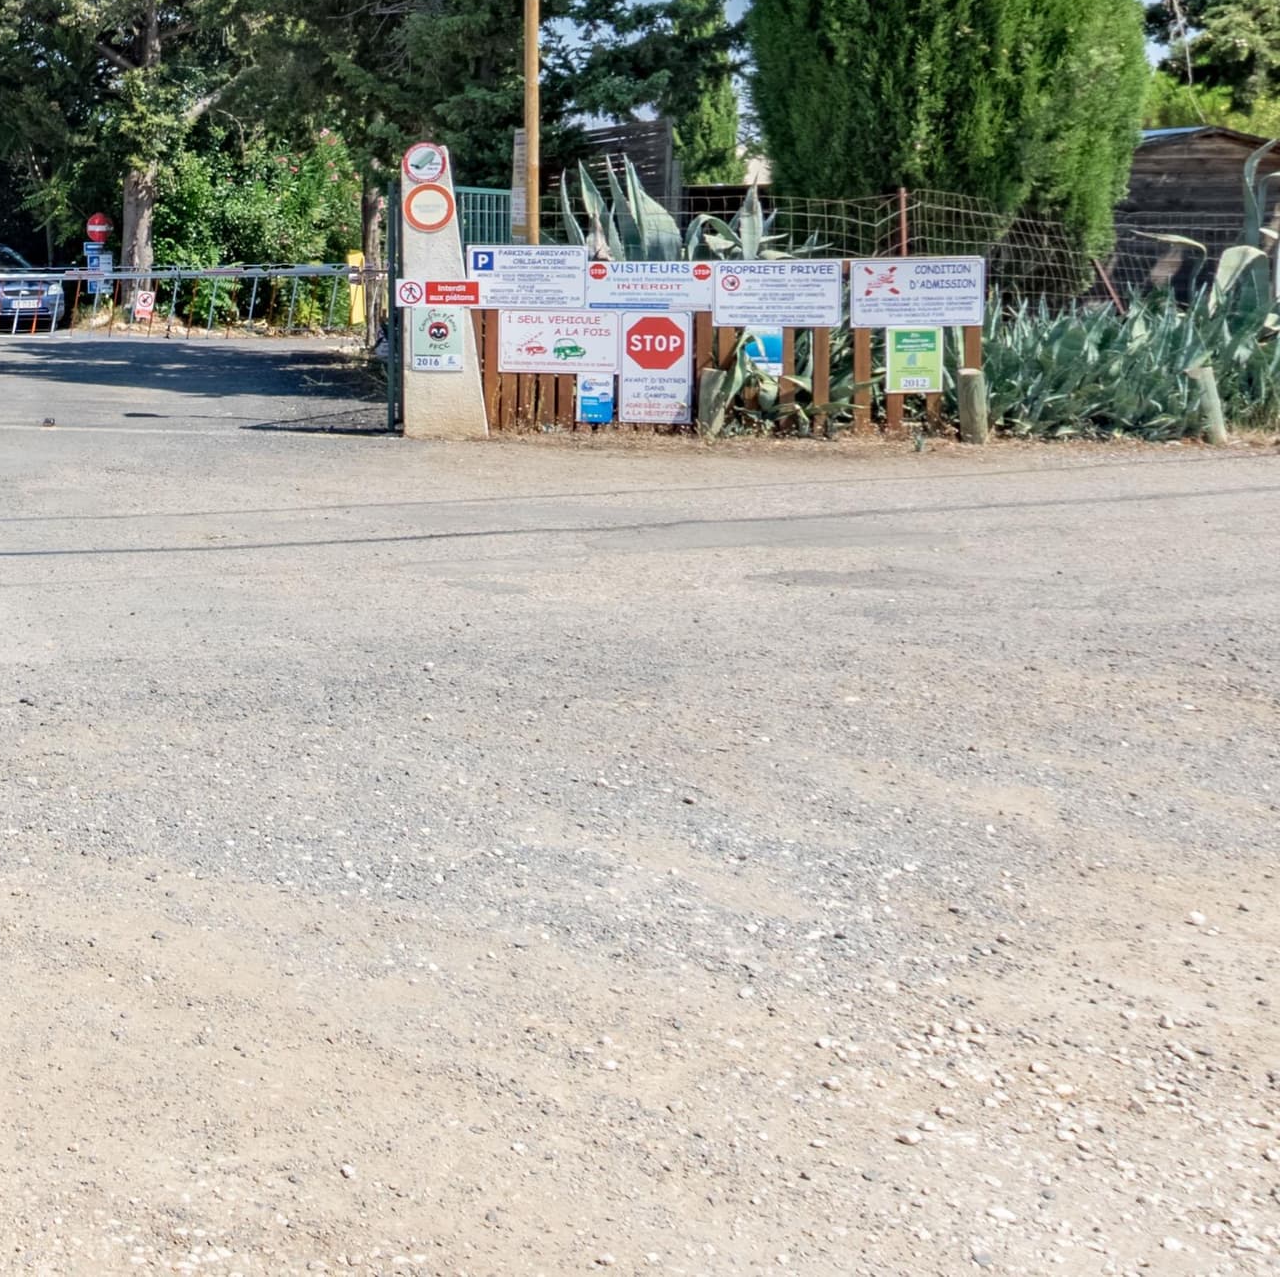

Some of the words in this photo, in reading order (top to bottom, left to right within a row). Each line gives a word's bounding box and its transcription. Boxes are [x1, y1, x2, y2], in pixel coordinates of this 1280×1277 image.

[478, 254, 489, 268] P
[610, 263, 690, 274] VISITEURS
[720, 265, 785, 275] PROPRIETE
[790, 265, 834, 275] PRIVEE
[914, 264, 971, 275] CONDITION
[909, 279, 977, 290] D'ADMISSION
[517, 315, 544, 324] SEUL
[548, 316, 601, 325] VEHICULE
[565, 328, 579, 336] LA
[583, 328, 611, 337] FOIS
[630, 335, 681, 352] STOP
[416, 358, 440, 367] 2016
[903, 379, 927, 388] 2012
